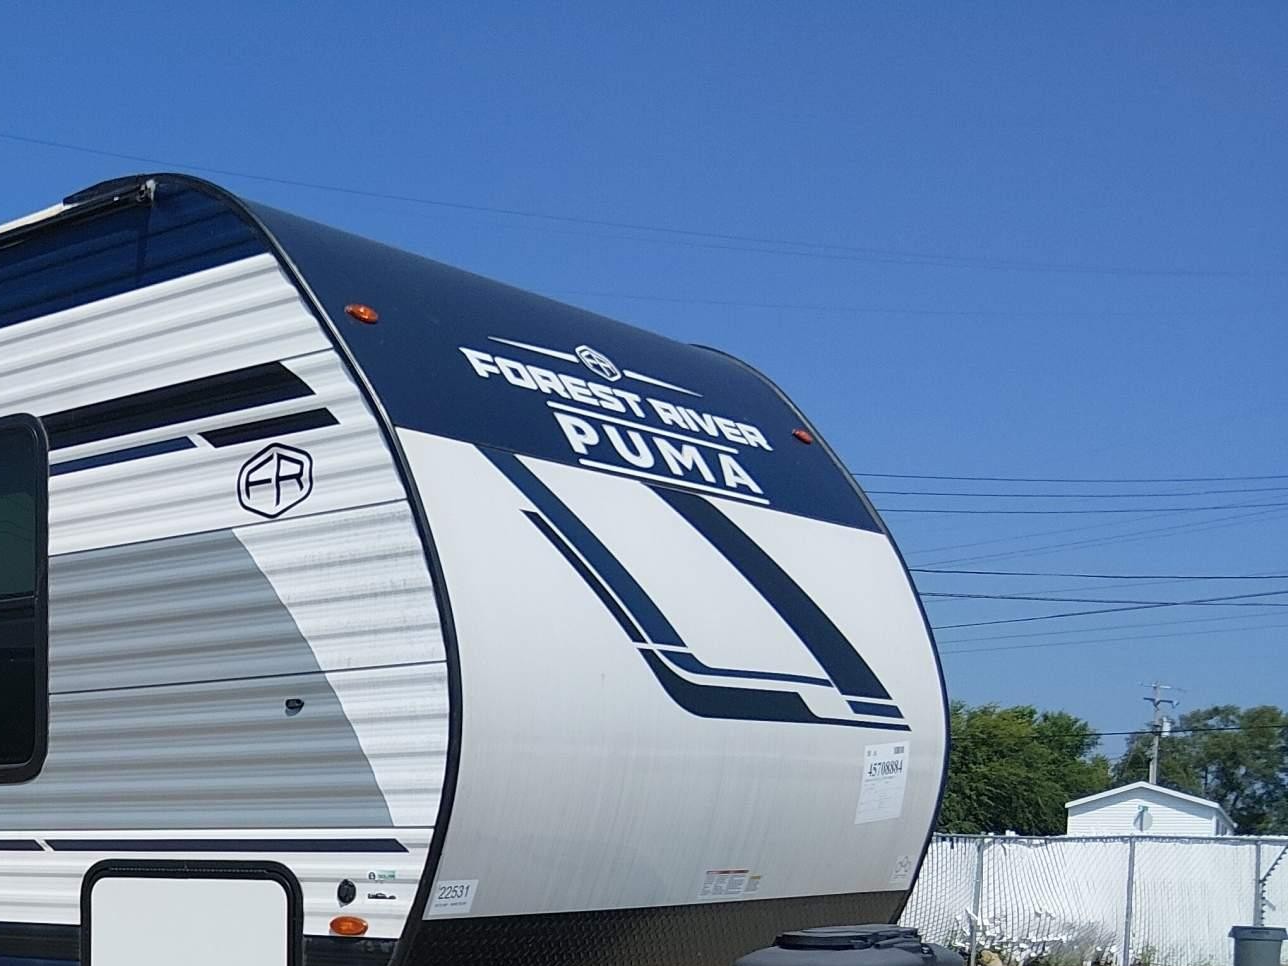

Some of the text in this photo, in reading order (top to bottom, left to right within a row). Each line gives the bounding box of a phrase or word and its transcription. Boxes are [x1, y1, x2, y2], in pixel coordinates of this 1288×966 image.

[459, 347, 774, 451] FOREST RIVER
[553, 411, 764, 494] PUMA
[868, 760, 903, 777] 45708884
[438, 885, 471, 900] 22531
